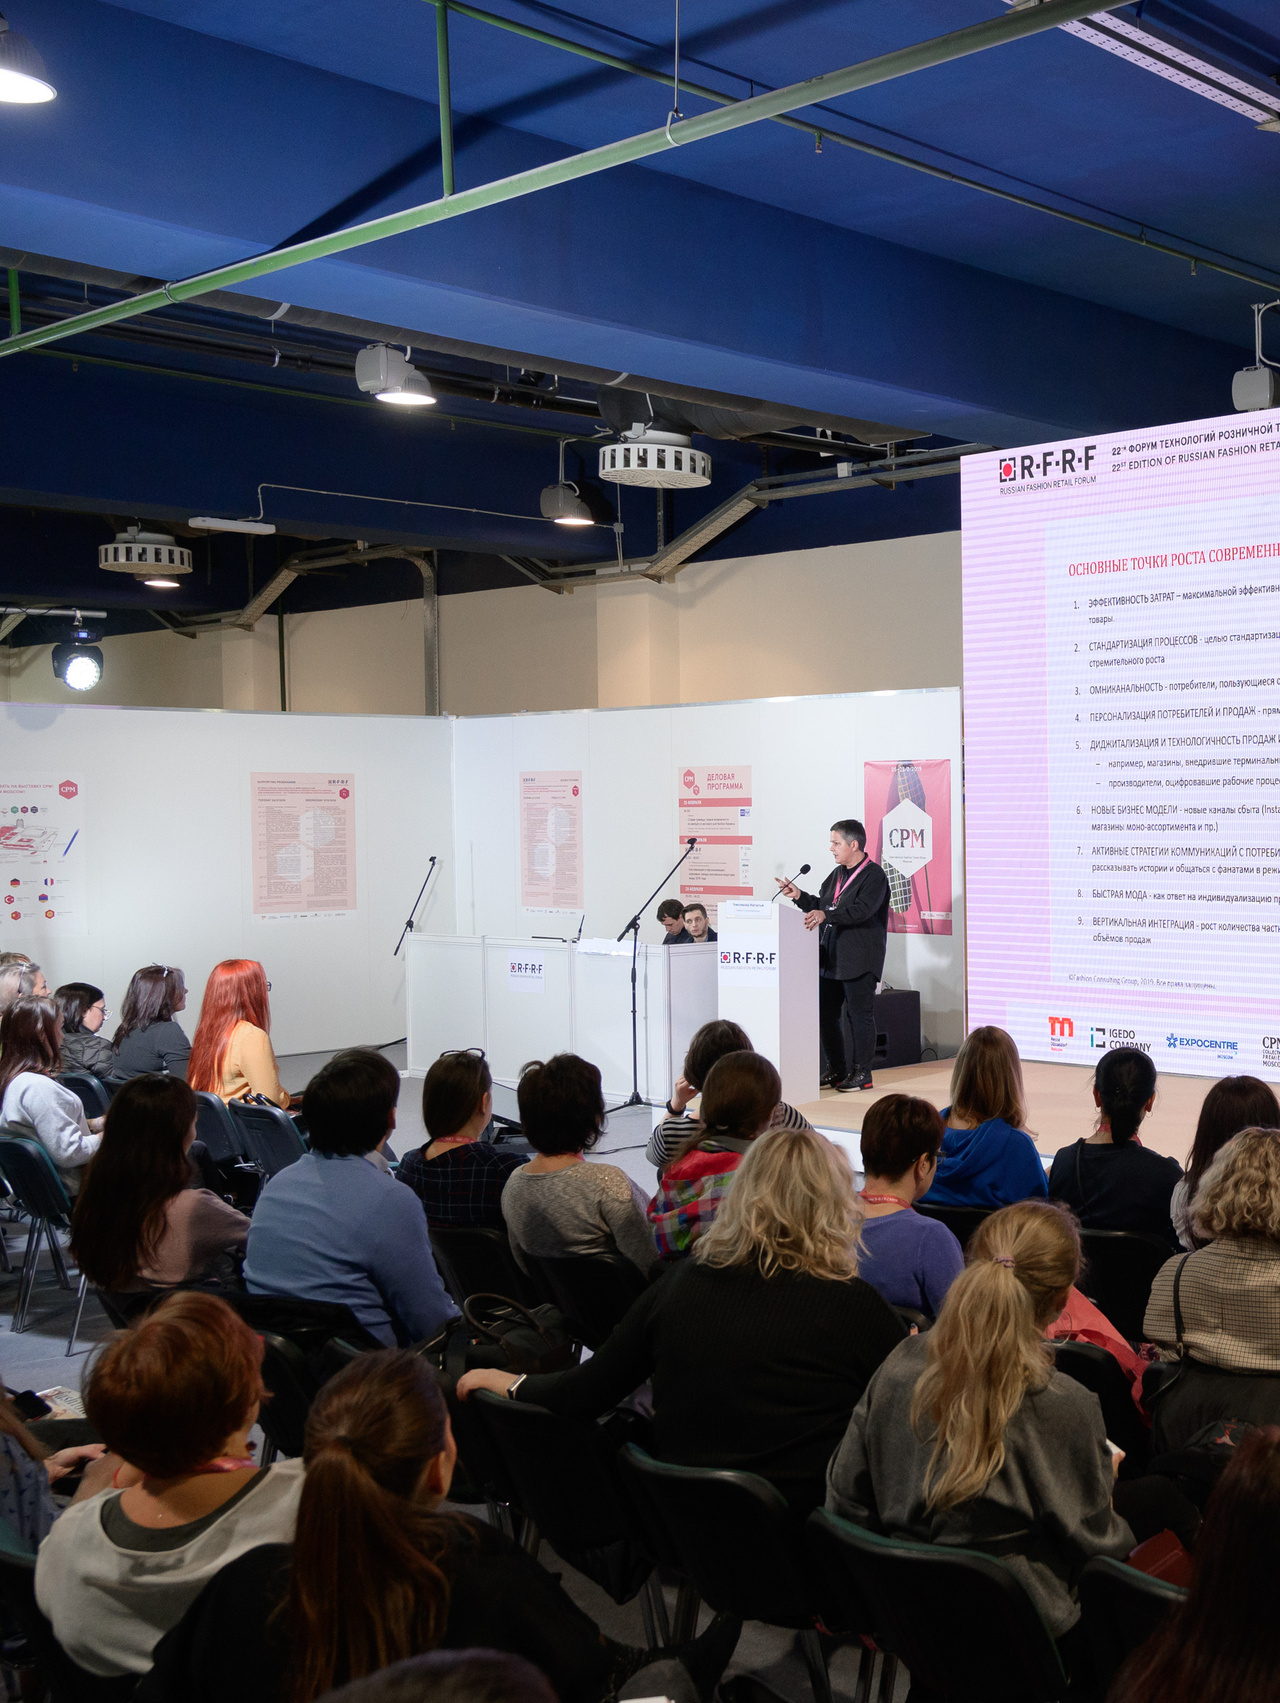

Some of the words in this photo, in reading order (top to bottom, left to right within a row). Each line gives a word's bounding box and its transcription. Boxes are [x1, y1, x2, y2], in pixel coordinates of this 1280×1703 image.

[1127, 441, 1157, 452] ФОРУМ
[1158, 432, 1216, 448] ТЕХНОЛОГИЙ
[1217, 424, 1273, 440] РОЗНИЧНОЙ
[1128, 457, 1162, 469] EDITION
[1163, 454, 1176, 465] OF
[1177, 450, 1215, 462] RUSSIAN
[1217, 444, 1257, 456] FASHION
[999, 485, 1025, 494] RUSSIAN
[1025, 481, 1052, 490] FASHION
[1052, 479, 1073, 488] RETAIL
[1073, 475, 1096, 484] FORUM
[1068, 558, 1128, 576] ОСНОВНЫЕ
[1129, 554, 1167, 570] ТОЧКИ
[1170, 550, 1206, 566] РОСТА
[1088, 594, 1149, 608] ЭФФЕКТИВНОСТЬ
[1149, 591, 1175, 602] ЗАТРАТ
[1181, 585, 1237, 599] максимальной
[707, 774, 735, 782] ДЕЛОВАЯ
[889, 828, 925, 848] CPM
[1091, 846, 1129, 855] АКТИВНЫЕ
[1130, 846, 1169, 856] СТРАТЕГИИ
[1170, 845, 1237, 857] КОММУНИКАЦИЙ
[1109, 1028, 1136, 1039] IGEDO
[1179, 1037, 1238, 1050] EXPOCENTRE
